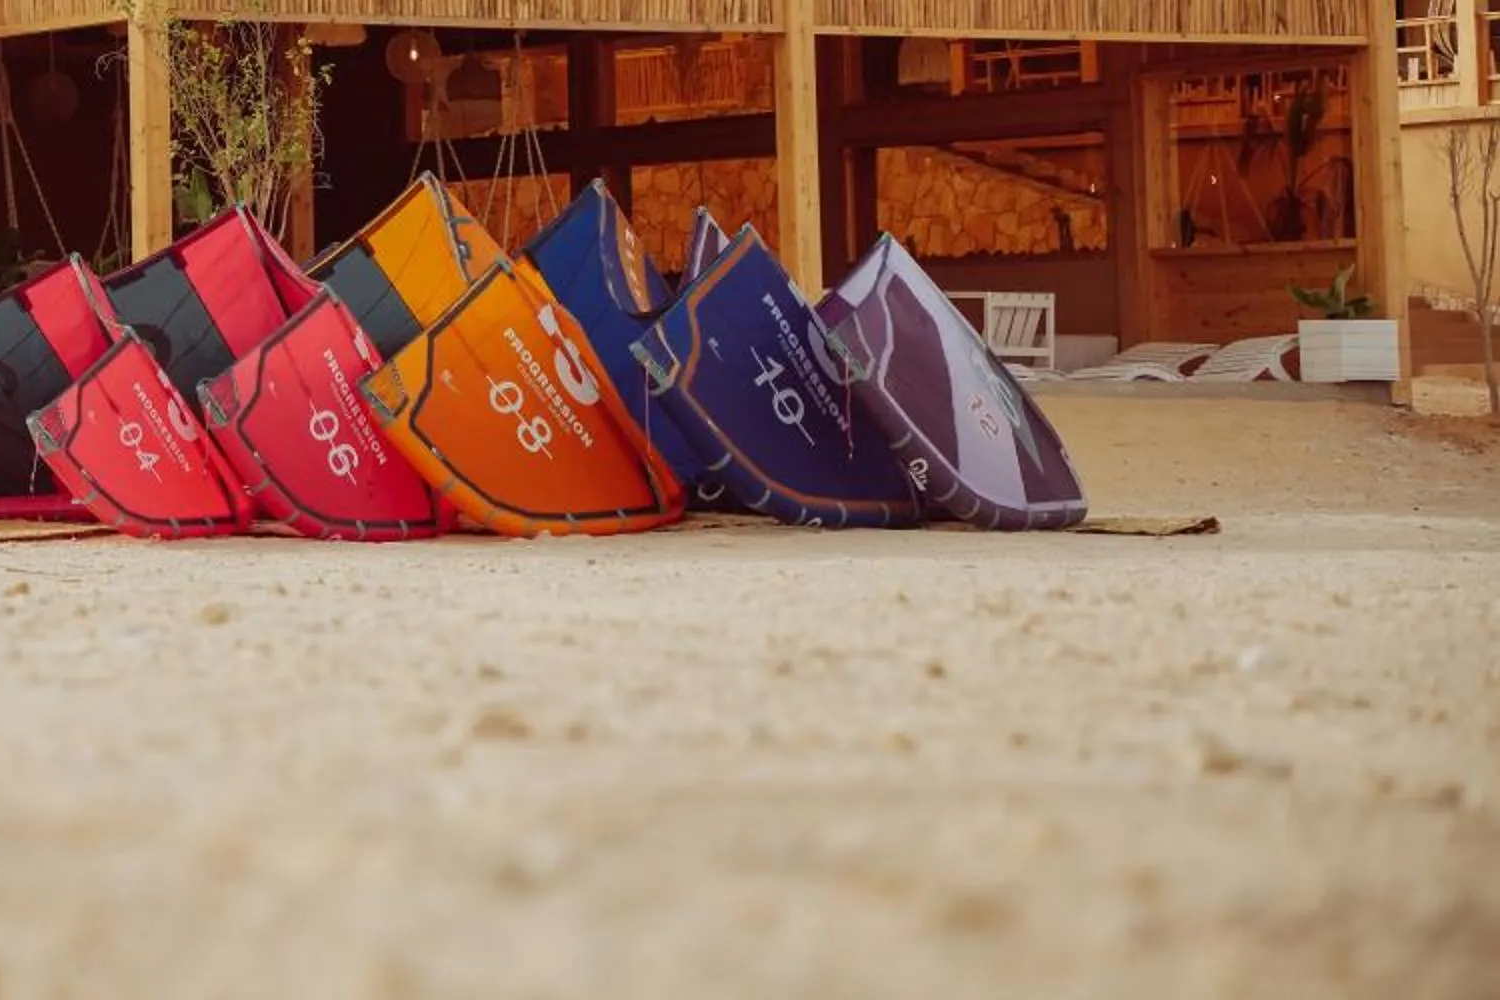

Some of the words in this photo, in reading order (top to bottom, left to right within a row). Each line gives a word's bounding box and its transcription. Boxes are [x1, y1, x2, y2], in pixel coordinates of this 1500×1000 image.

[503, 327, 594, 447] PROGRESSION
[754, 356, 805, 425] 10
[761, 293, 850, 432] PROGRESSION
[309, 409, 359, 477] 06
[323, 348, 388, 466] PROGRESSION
[489, 381, 552, 453] 08
[120, 422, 160, 470] 04
